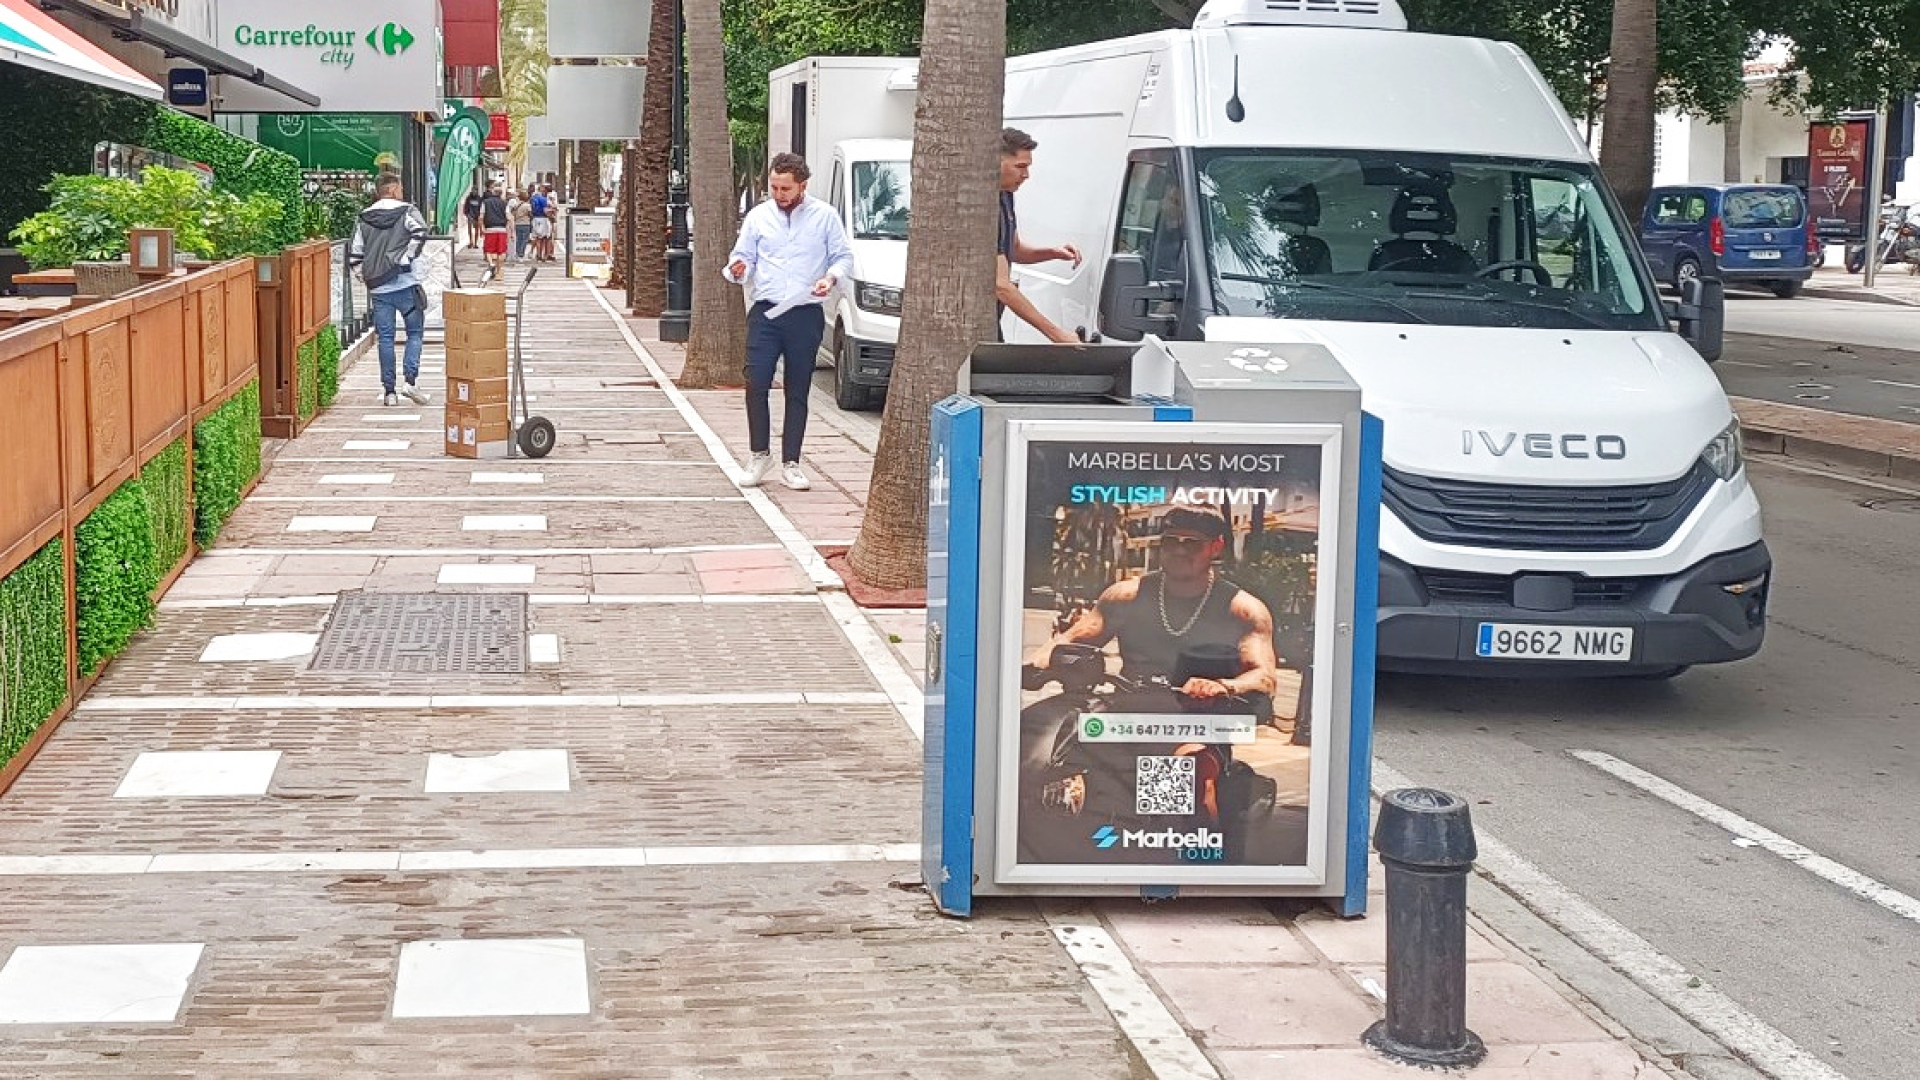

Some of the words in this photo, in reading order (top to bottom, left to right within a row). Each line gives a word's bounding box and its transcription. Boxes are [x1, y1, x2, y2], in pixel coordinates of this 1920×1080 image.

[234, 24, 355, 46] Carrefour
[320, 48, 355, 70] city
[1462, 429, 1626, 460] IVECO
[1068, 452, 1213, 472] MARBELLA'S
[1219, 454, 1285, 473] MOST
[1071, 486, 1165, 504] STYLISH
[1171, 487, 1279, 505] ACTIVITY
[1497, 630, 1563, 656] 9662
[1573, 631, 1625, 656] NMG
[1110, 724, 1134, 736] +34
[1136, 724, 1160, 736] 647
[1122, 827, 1223, 848] Marbella
[1176, 848, 1223, 860] TOUR
